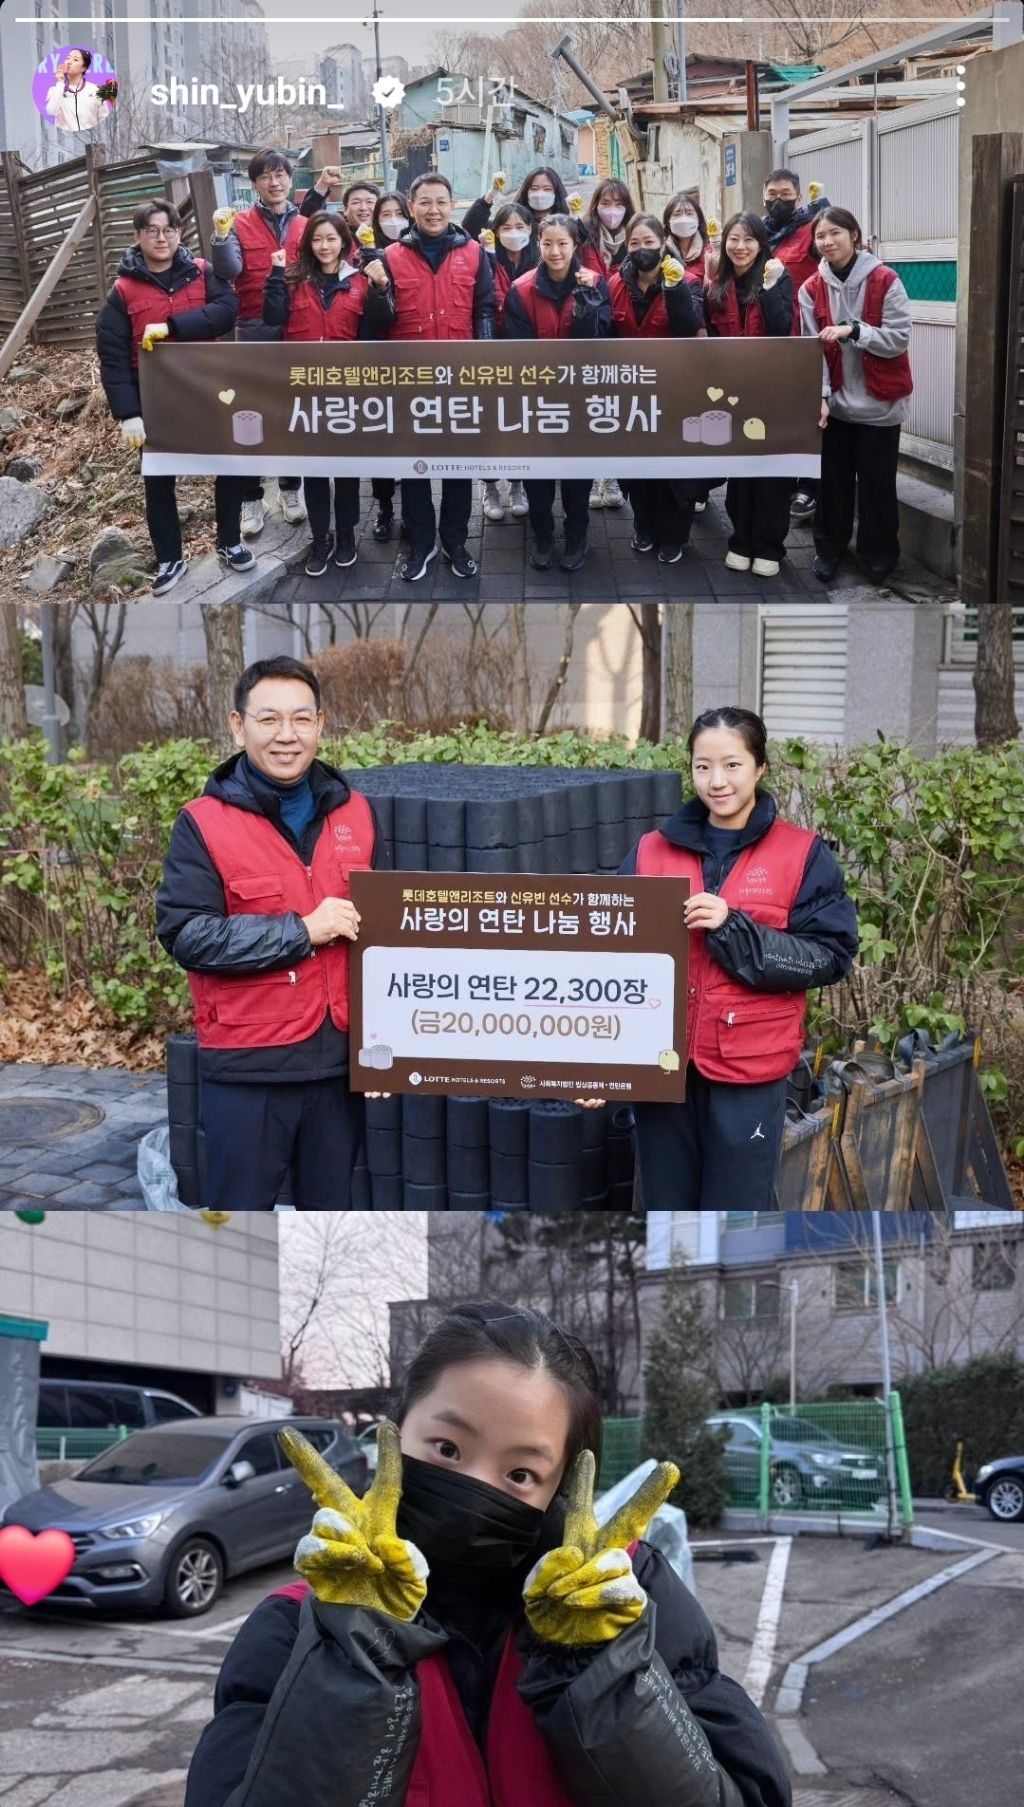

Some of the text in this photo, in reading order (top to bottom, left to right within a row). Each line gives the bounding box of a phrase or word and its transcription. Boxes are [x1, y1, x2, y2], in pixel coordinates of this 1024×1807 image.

[289, 364, 657, 386] 롯데호텔앤리조트와 신유빈 선수가 함께하는
[288, 394, 662, 434] 사랑의 연탄 나눔 행사
[402, 889, 635, 907] 롯데호텔앤리조트와 신유빈 선수가 함께하는
[400, 906, 637, 936] 사랑의 연탄 나눔 행사
[387, 973, 648, 1004] 사랑의 연탄 22,300장
[411, 1009, 622, 1040] (금20,000,000원)
